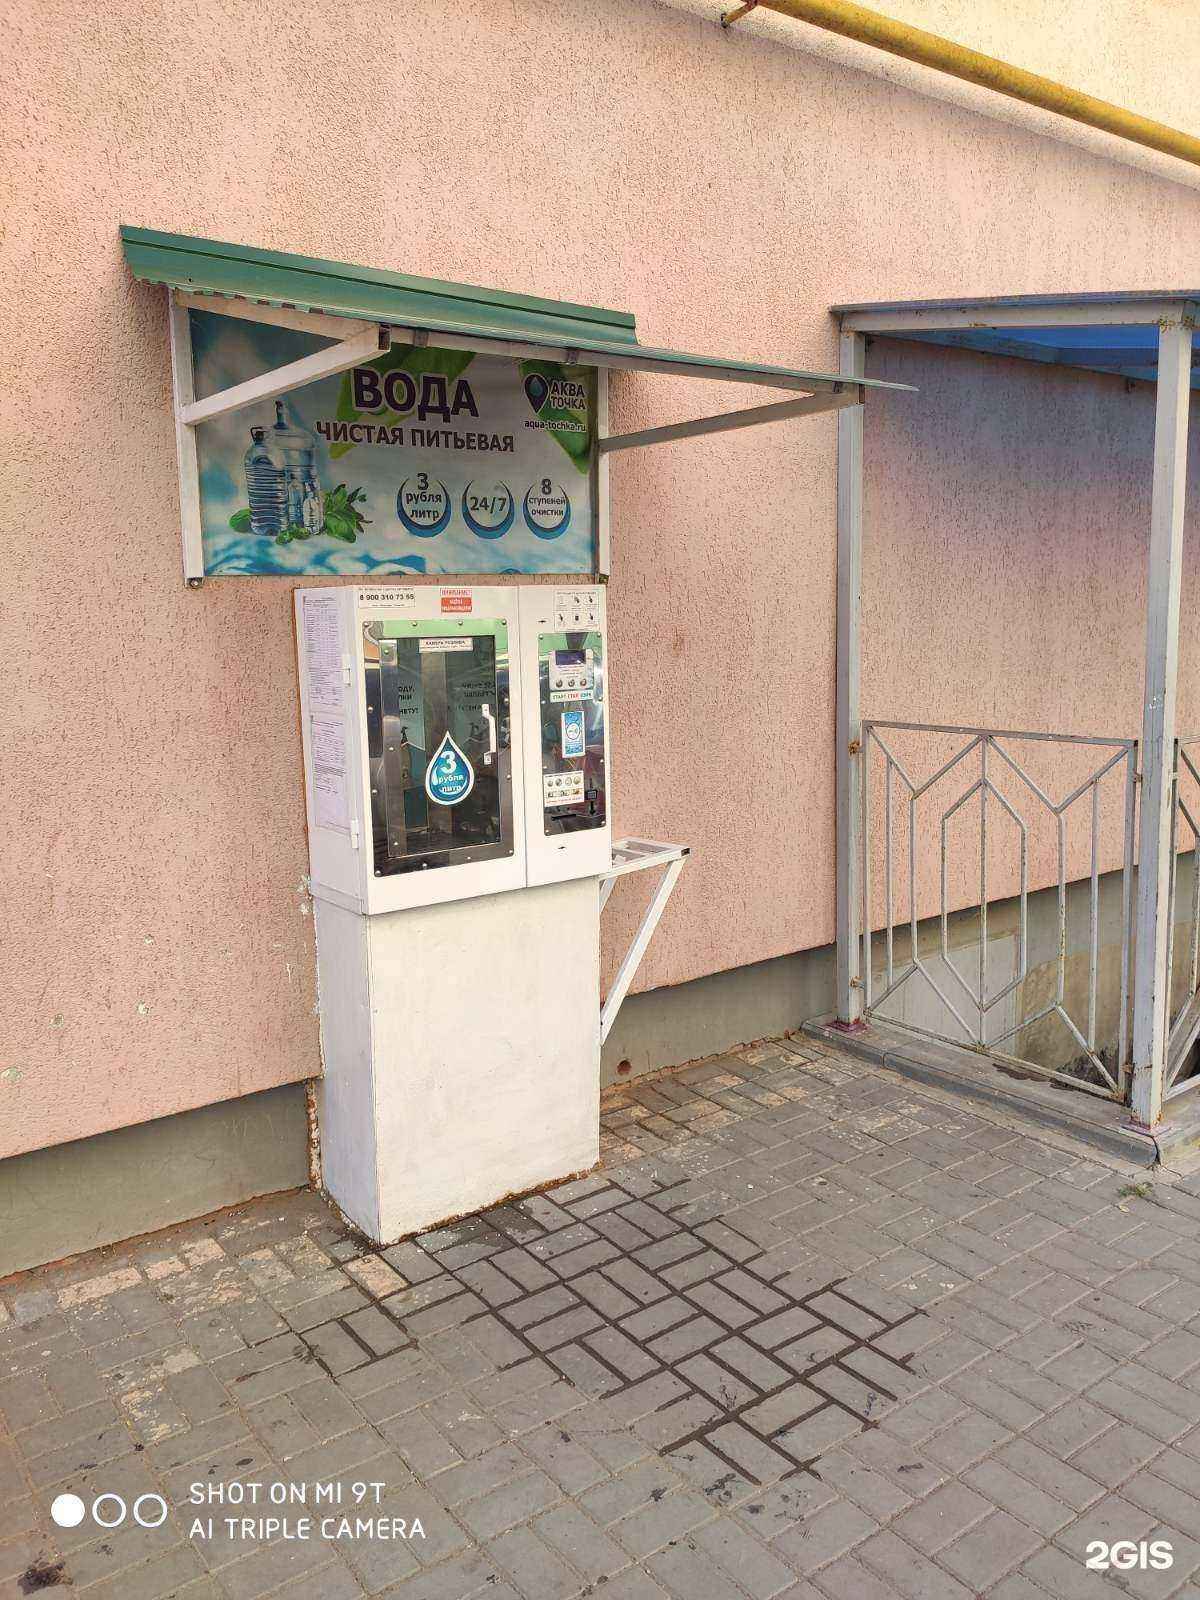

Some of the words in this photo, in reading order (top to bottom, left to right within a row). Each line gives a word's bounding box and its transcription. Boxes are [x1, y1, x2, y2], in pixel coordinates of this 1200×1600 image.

[353, 367, 480, 423] ВОДА
[551, 381, 585, 398] АКВА
[551, 395, 586, 410] ТОЧКА
[524, 420, 586, 432] aqua-tochka.ru
[316, 420, 404, 446] ЧИСТАЯ
[411, 428, 515, 453] ПИТЬЕВАЯ
[416, 472, 429, 491] 3
[541, 478, 552, 496] 8
[405, 491, 442, 504] рубля
[470, 496, 507, 514] 24/7
[528, 496, 566, 506] ступеней
[410, 508, 440, 521] литр
[531, 508, 564, 517] очистки
[440, 750, 457, 774] 3
[438, 774, 464, 785] рубля
[441, 785, 462, 793] литр
